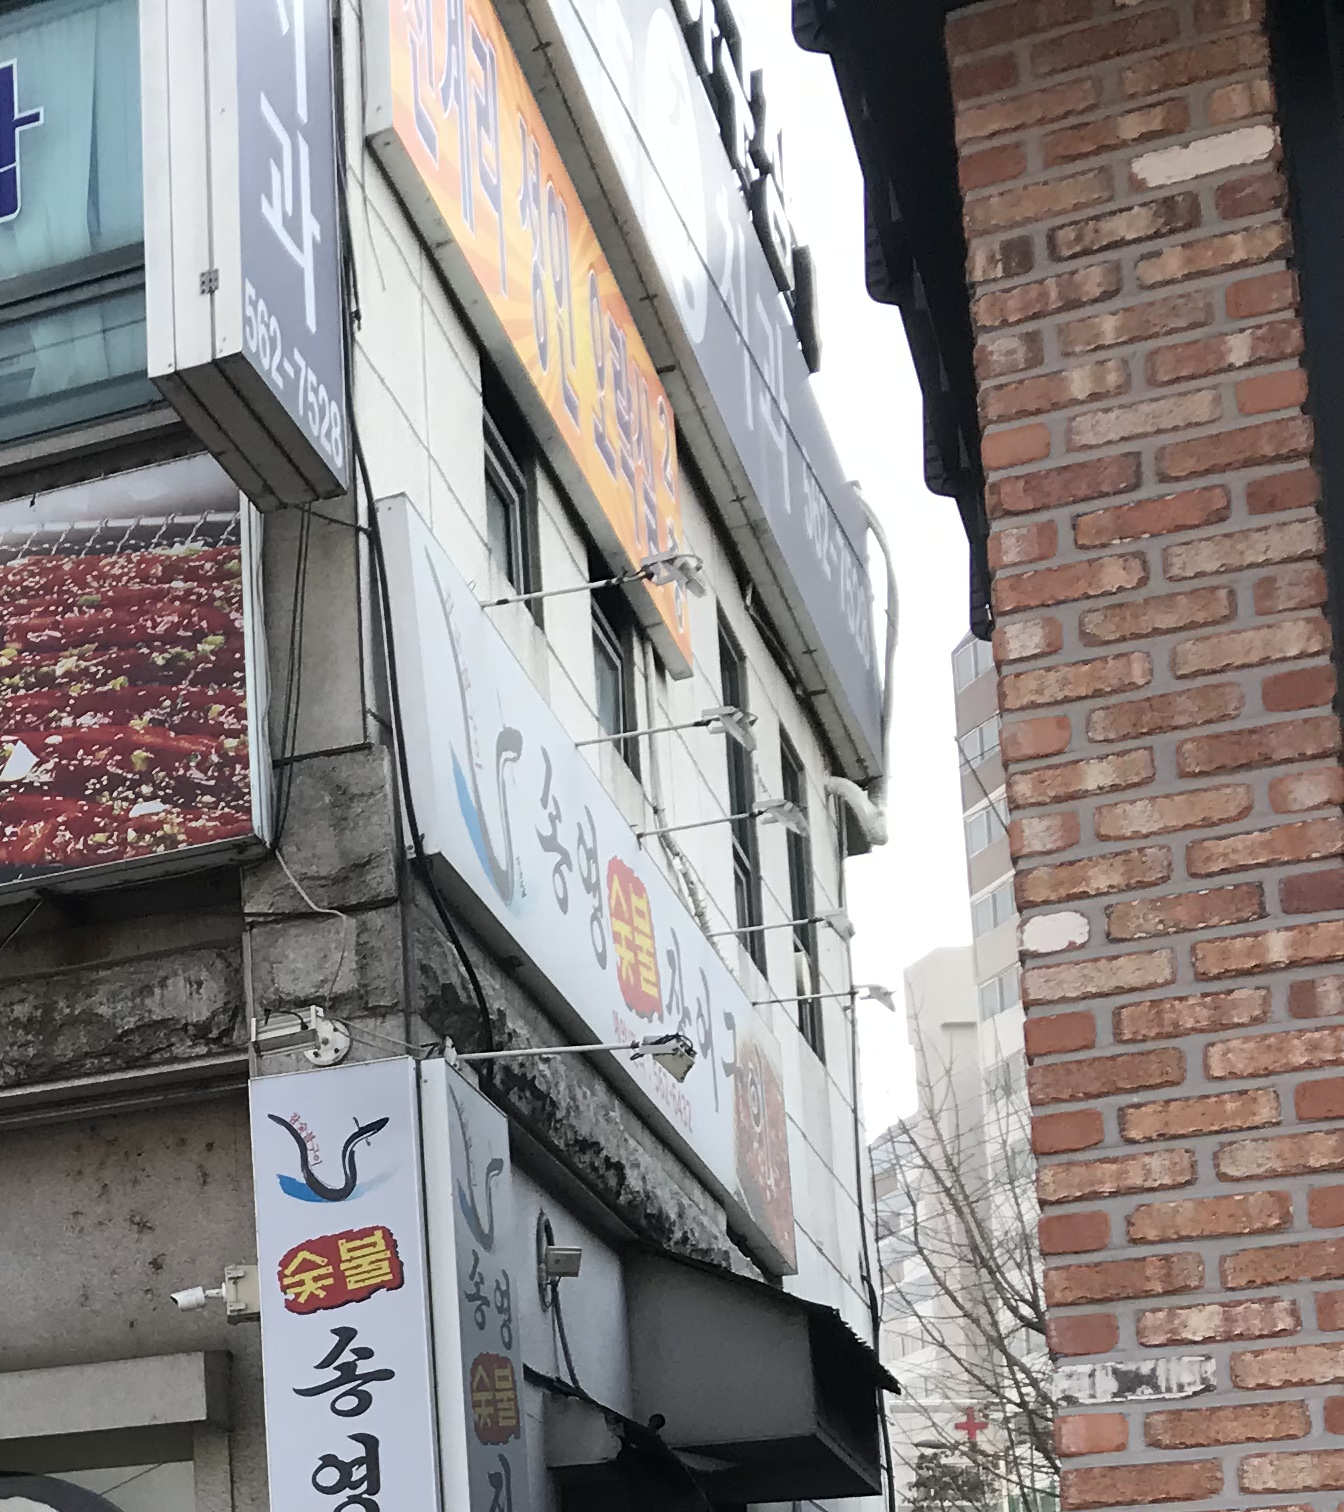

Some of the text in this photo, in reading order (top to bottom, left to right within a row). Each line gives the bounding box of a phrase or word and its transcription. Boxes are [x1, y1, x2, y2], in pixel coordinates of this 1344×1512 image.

[244, 277, 345, 469] 562-7528
[610, 876, 662, 1001] 숯불
[282, 1229, 395, 1304] 숯불
[472, 1363, 518, 1429] 숯불
